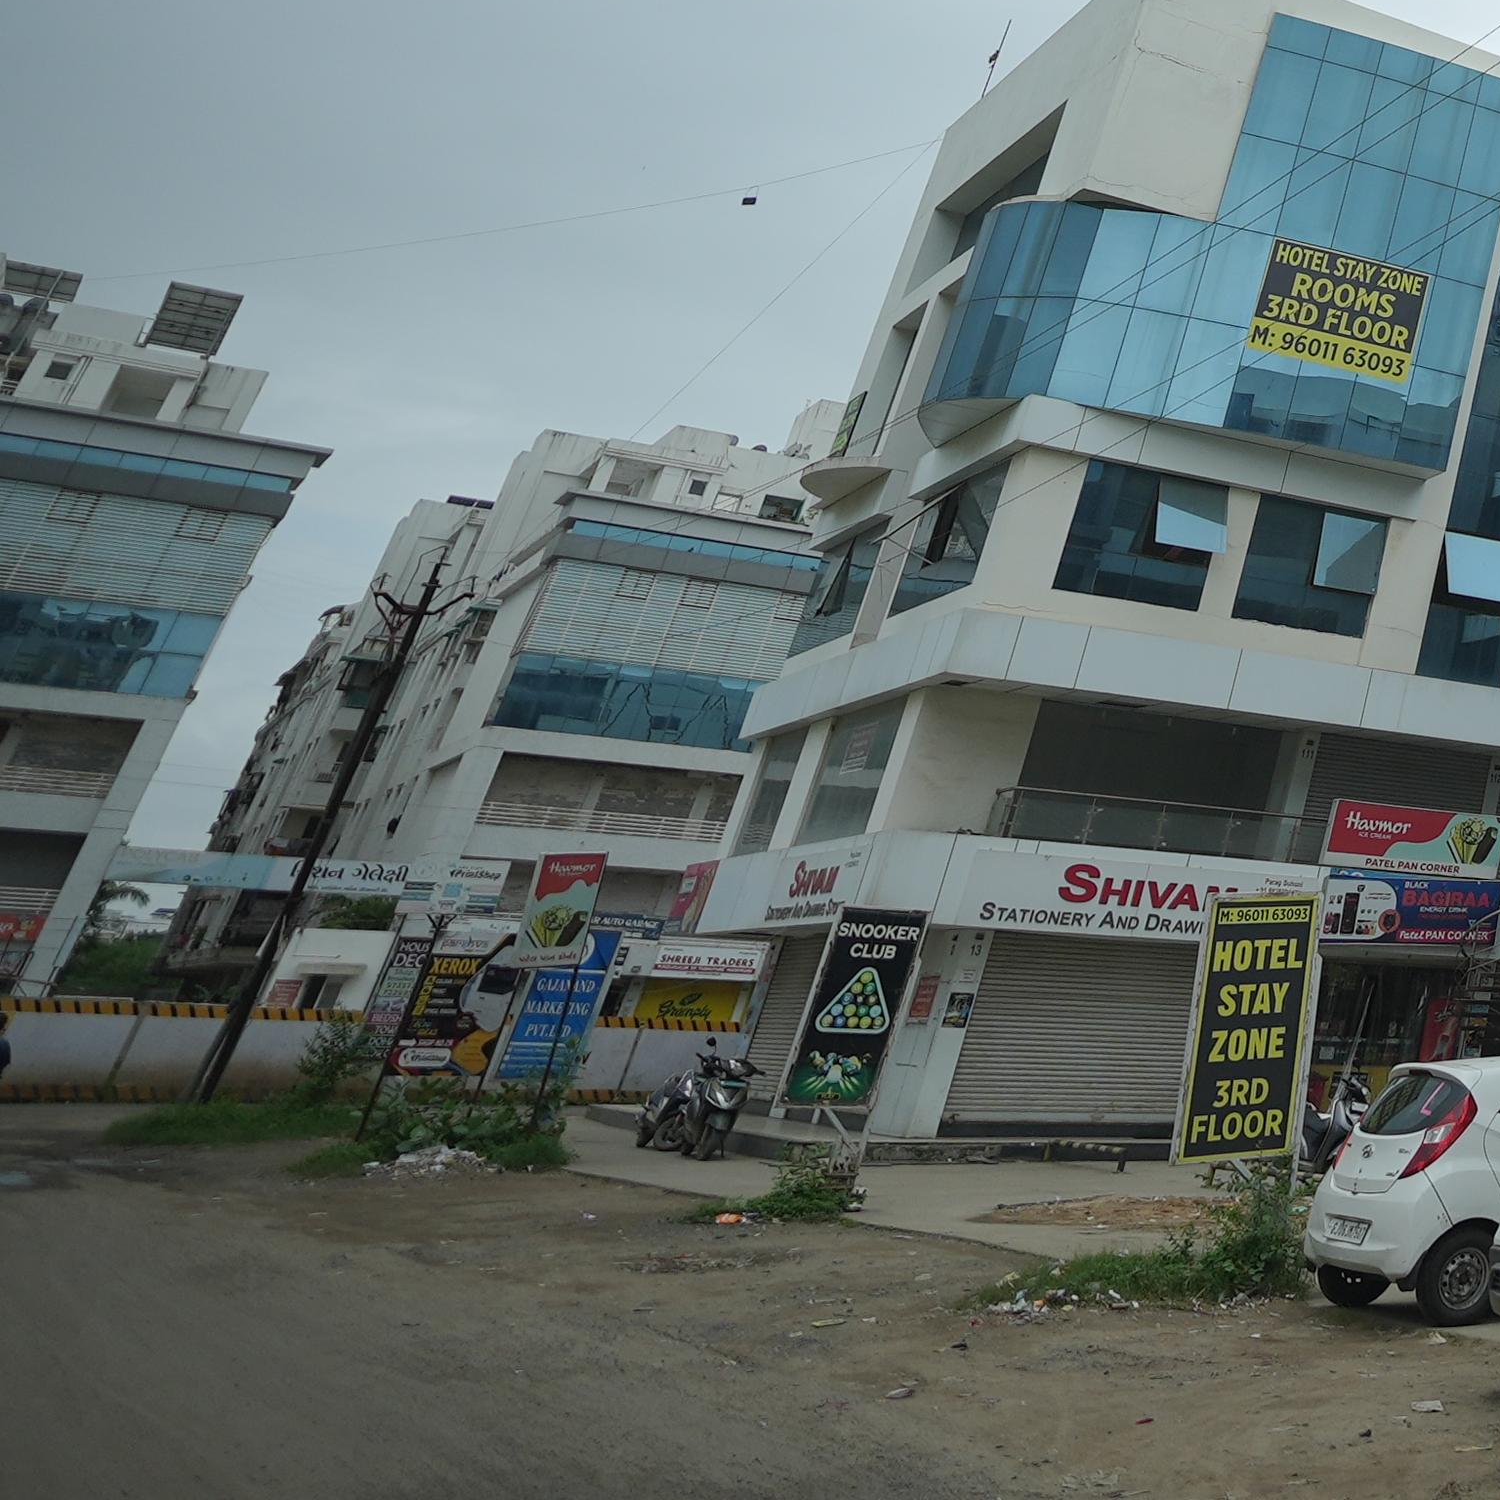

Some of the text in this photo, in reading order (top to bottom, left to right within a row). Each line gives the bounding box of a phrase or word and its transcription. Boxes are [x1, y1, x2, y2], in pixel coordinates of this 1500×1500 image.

[1275, 243, 1424, 296] HOTEL STAY ZONE
[1291, 272, 1396, 318] ROOMS
[1262, 294, 1409, 350] 3RD FLOOR
[1251, 325, 1405, 377] M: 96011 63093
[1344, 811, 1412, 835] Havmor
[1365, 858, 1461, 874] PATEL PAN CORNER
[789, 860, 840, 898] SHIVAM
[1058, 863, 1239, 913] SHIVA
[1404, 881, 1430, 889] BLACK
[1402, 889, 1491, 908] BAGIRAA
[979, 902, 1095, 930] STATIONERY
[1219, 907, 1308, 923] M: 96011 63093
[838, 922, 920, 941] SNOOKER
[1425, 931, 1445, 941] PAN
[399, 941, 431, 953] HOUS
[849, 943, 898, 960] CLUB
[971, 944, 982, 956] 13
[1212, 938, 1303, 973] HOTEL
[393, 953, 427, 968] DEC
[429, 957, 482, 974] XEROX
[659, 954, 755, 967] SHREEJI TRADERS
[525, 1000, 591, 1016] MARKEING
[1217, 982, 1290, 1017] STAY
[371, 1012, 401, 1023] BEDSH
[525, 1023, 571, 1037] PVT.LD
[1207, 1026, 1286, 1063] ZONE
[1212, 1077, 1270, 1108] 3RD
[1190, 1109, 1284, 1144] FLOOR
